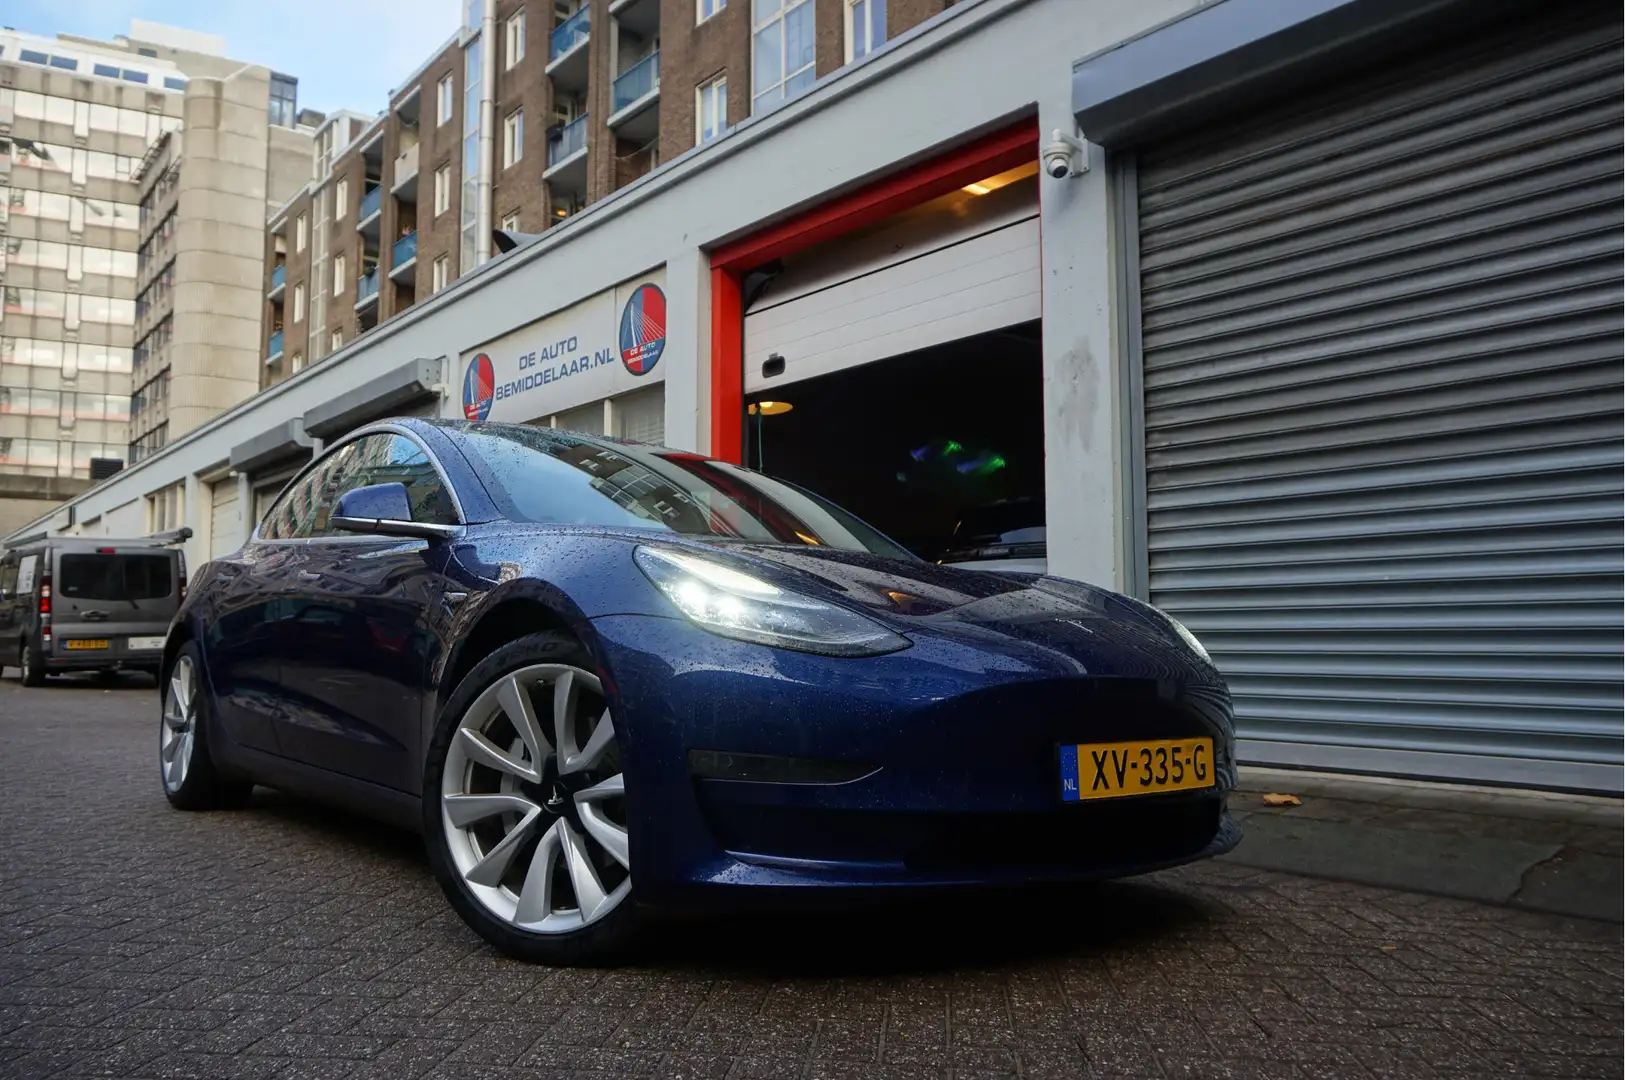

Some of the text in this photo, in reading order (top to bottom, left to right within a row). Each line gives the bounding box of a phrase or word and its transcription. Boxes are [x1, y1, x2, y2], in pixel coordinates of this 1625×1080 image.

[519, 336, 578, 371] DE AUTO
[629, 341, 656, 356] DE AUTO
[496, 348, 615, 401] BEMIDDELAAR.NL
[1064, 778, 1077, 791] NL
[1091, 744, 1206, 791] XV-335-G
